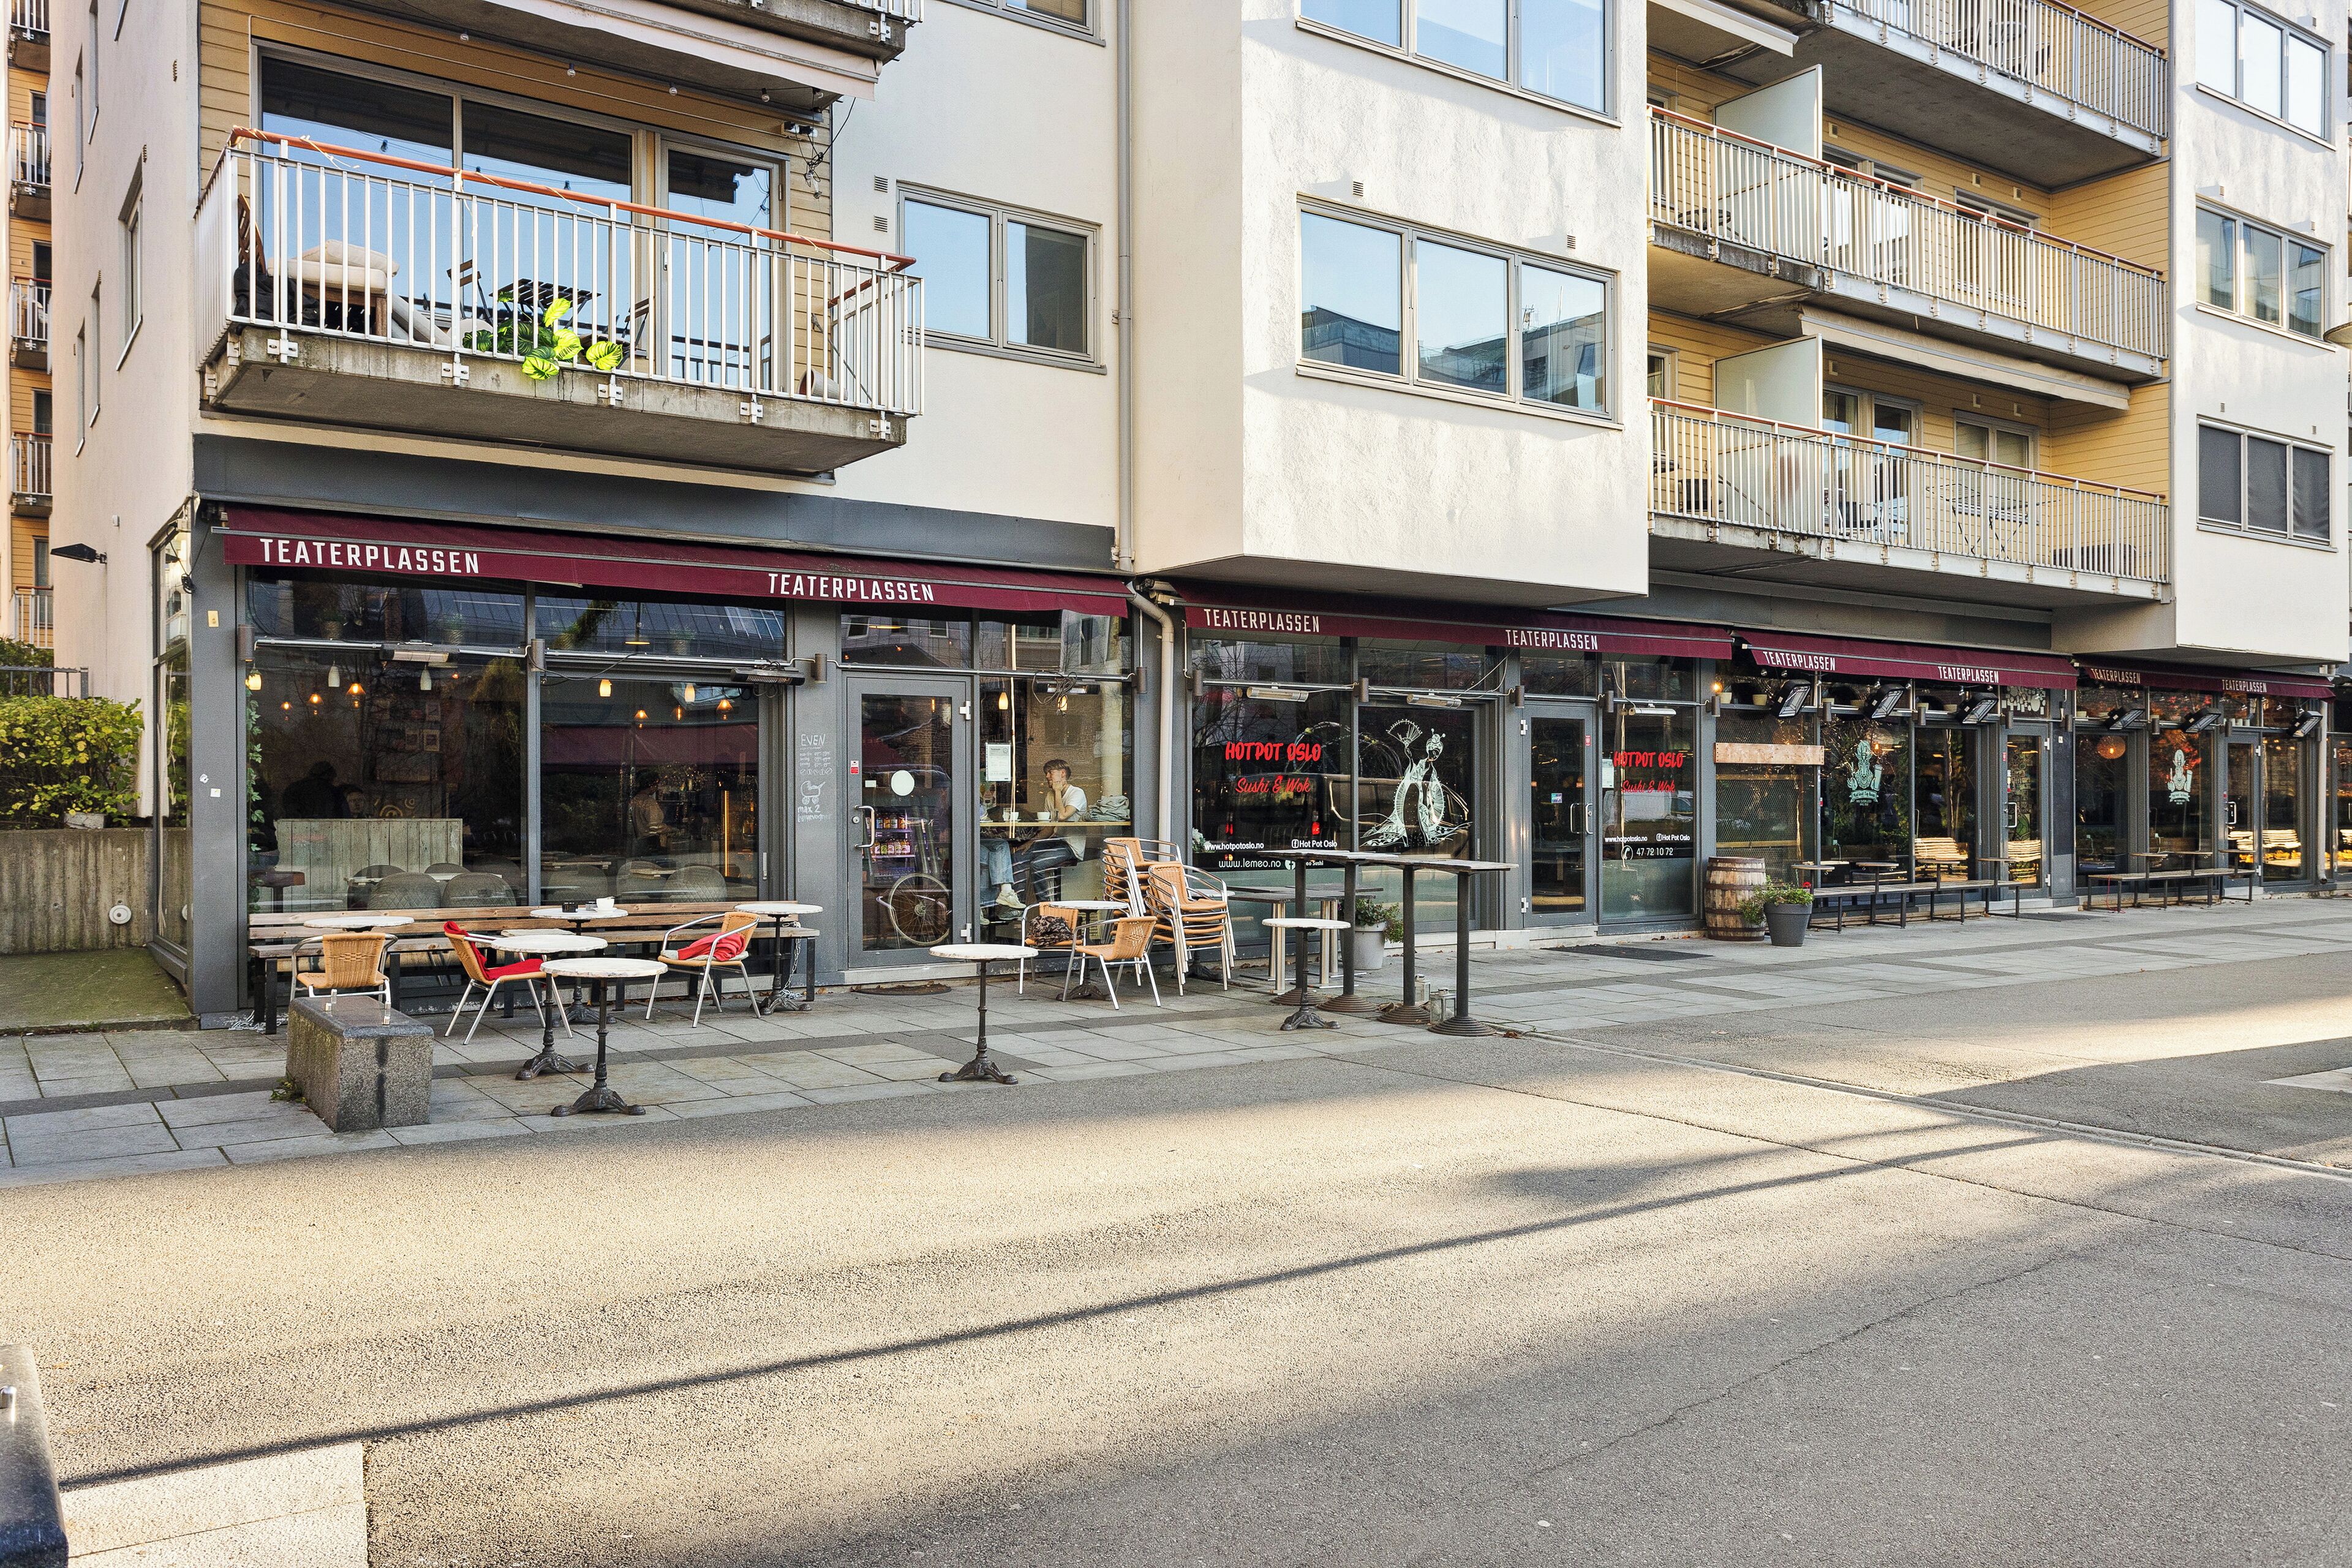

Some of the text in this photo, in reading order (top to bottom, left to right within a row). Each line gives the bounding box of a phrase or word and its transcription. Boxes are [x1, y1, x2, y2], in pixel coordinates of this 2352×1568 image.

[260, 538, 479, 574] TEATERPLASSEN
[768, 573, 934, 601] TEATERPLASSEN
[1204, 608, 1319, 633] TEATERPLASSEN
[1505, 629, 1598, 650] TEATERPLASSEN
[1762, 651, 1836, 671] TEATERPLASSEN
[1937, 666, 1999, 684] TEATERPLASSEN
[2090, 668, 2141, 684] TEATERPLASSEN
[2222, 679, 2267, 693] TEATERPLASSEN
[801, 733, 826, 747] EVEN
[1225, 741, 1321, 761] HOTPOT OSLO
[1613, 751, 1684, 767] HOTPOT OSLO
[1235, 775, 1311, 793] Sushi & Wok
[1621, 780, 1676, 794] Sushi & Wok
[814, 804, 821, 813] 2
[1204, 842, 1264, 851] www.hotpotoslo.no
[1636, 848, 1645, 856] 47
[1665, 847, 1673, 856] 72
[1218, 858, 1281, 868] www.lemeo.no
